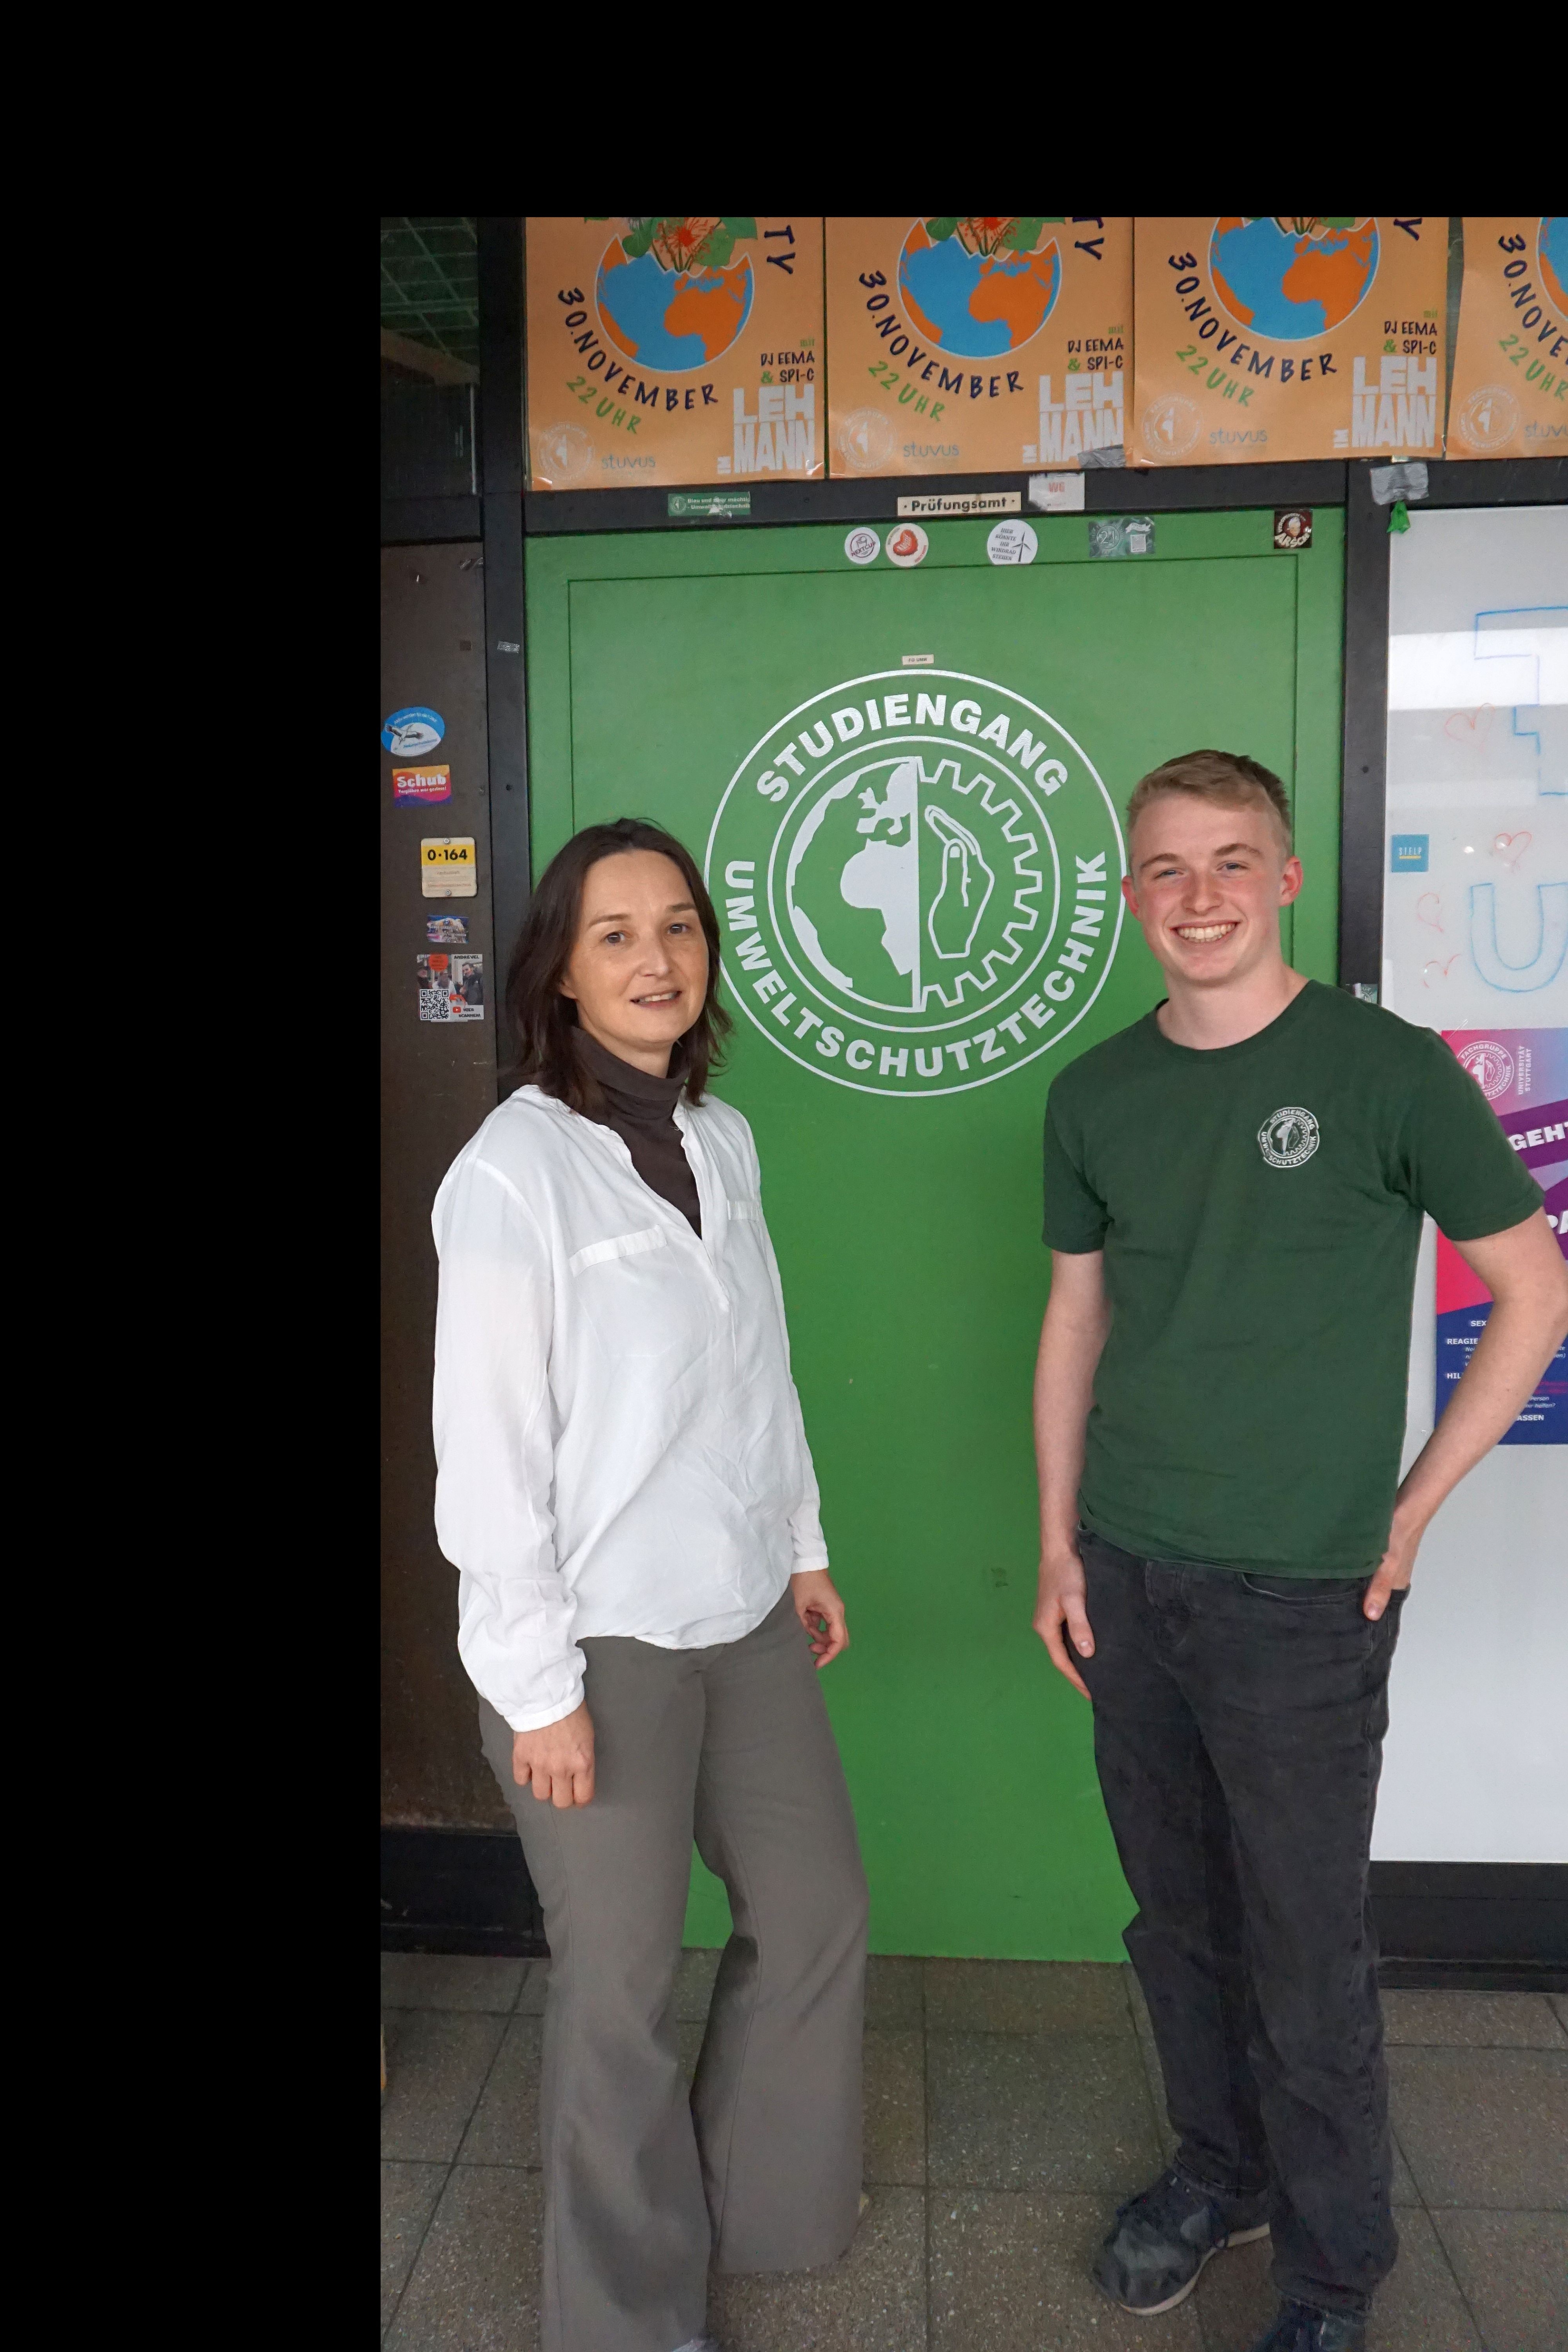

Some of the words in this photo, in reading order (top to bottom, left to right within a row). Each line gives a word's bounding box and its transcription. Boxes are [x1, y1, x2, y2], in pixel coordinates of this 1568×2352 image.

[1498, 234, 1568, 365] 30.NOVE
[1169, 252, 1337, 383] 30.NOVEMBER
[859, 270, 1024, 399] 30.NOVEMBER
[1384, 320, 1397, 334] DJ
[1402, 321, 1438, 336] EEMA
[558, 287, 718, 411] 30.NOVEMBER
[1068, 340, 1081, 354] DJ
[1085, 337, 1124, 352] EEMA
[1383, 339, 1396, 353] &
[1403, 340, 1437, 355] SPI-C
[761, 353, 774, 366] DJ
[778, 351, 815, 365] EEMA
[1067, 358, 1082, 372] &
[1087, 355, 1123, 371] SPI-C
[761, 371, 773, 383] &
[780, 368, 815, 383] SPI-C
[1353, 355, 1437, 395] LEH
[1039, 370, 1124, 412] LEH
[733, 383, 815, 423] LEH
[1352, 393, 1437, 448] MANN
[1039, 408, 1124, 463] MANN
[1209, 428, 1267, 444] stuvus
[734, 419, 815, 474] MANN
[903, 441, 959, 457] stuvus
[601, 454, 656, 469] stuvus
[911, 497, 1006, 512] Prüfungsamt
[991, 546, 1016, 555] WINDRAD
[757, 693, 1069, 803] STUDIENGANG
[397, 773, 447, 788] Schub
[1399, 847, 1422, 855] STELP
[725, 851, 1107, 1078] UMWELTSCHUTZTECHNIK
[1461, 1044, 1507, 1060] FACHGRUPPE
[1270, 1109, 1315, 1130] STUDIENGANG
[1508, 1122, 1568, 1151] GEH
